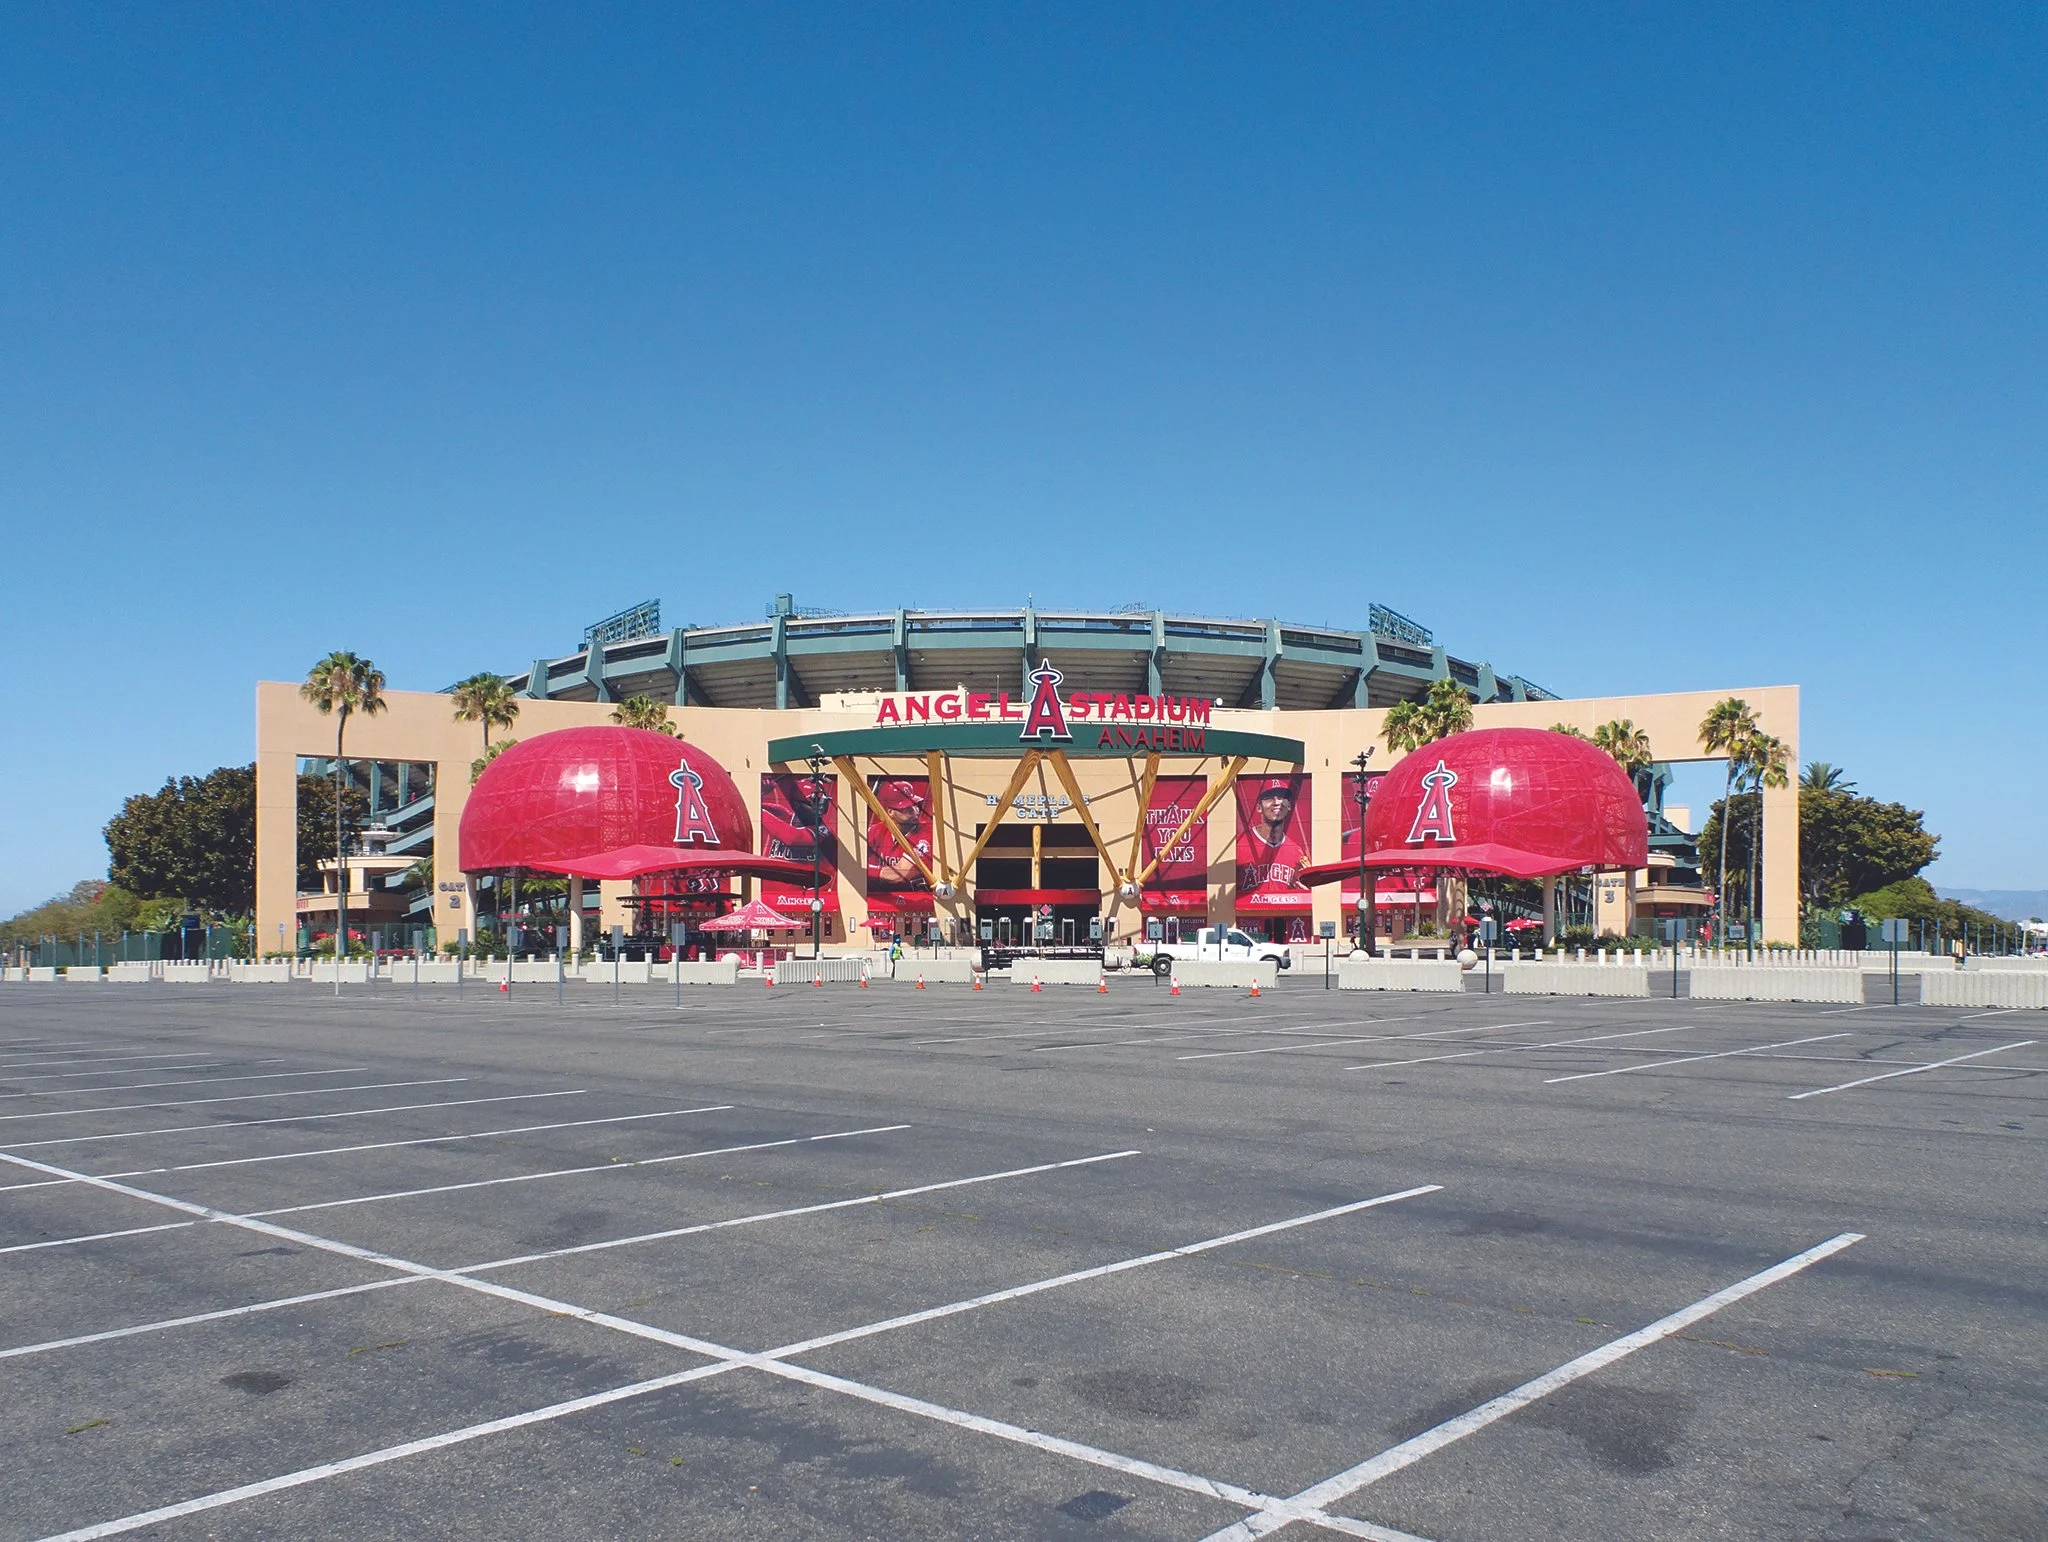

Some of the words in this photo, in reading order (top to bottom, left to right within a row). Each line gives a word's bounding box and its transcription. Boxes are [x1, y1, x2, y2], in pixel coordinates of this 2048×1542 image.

[876, 692, 1024, 723] ANGEL
[1068, 692, 1212, 724] STADIUM
[1098, 725, 1206, 752] ANAHEIM
[986, 794, 1091, 806] HMEPLAE
[1016, 808, 1060, 819] GATE
[438, 882, 466, 893] GAT
[449, 895, 461, 909] 2
[1250, 893, 1298, 904] ANGELS
[1604, 890, 1615, 904] 3
